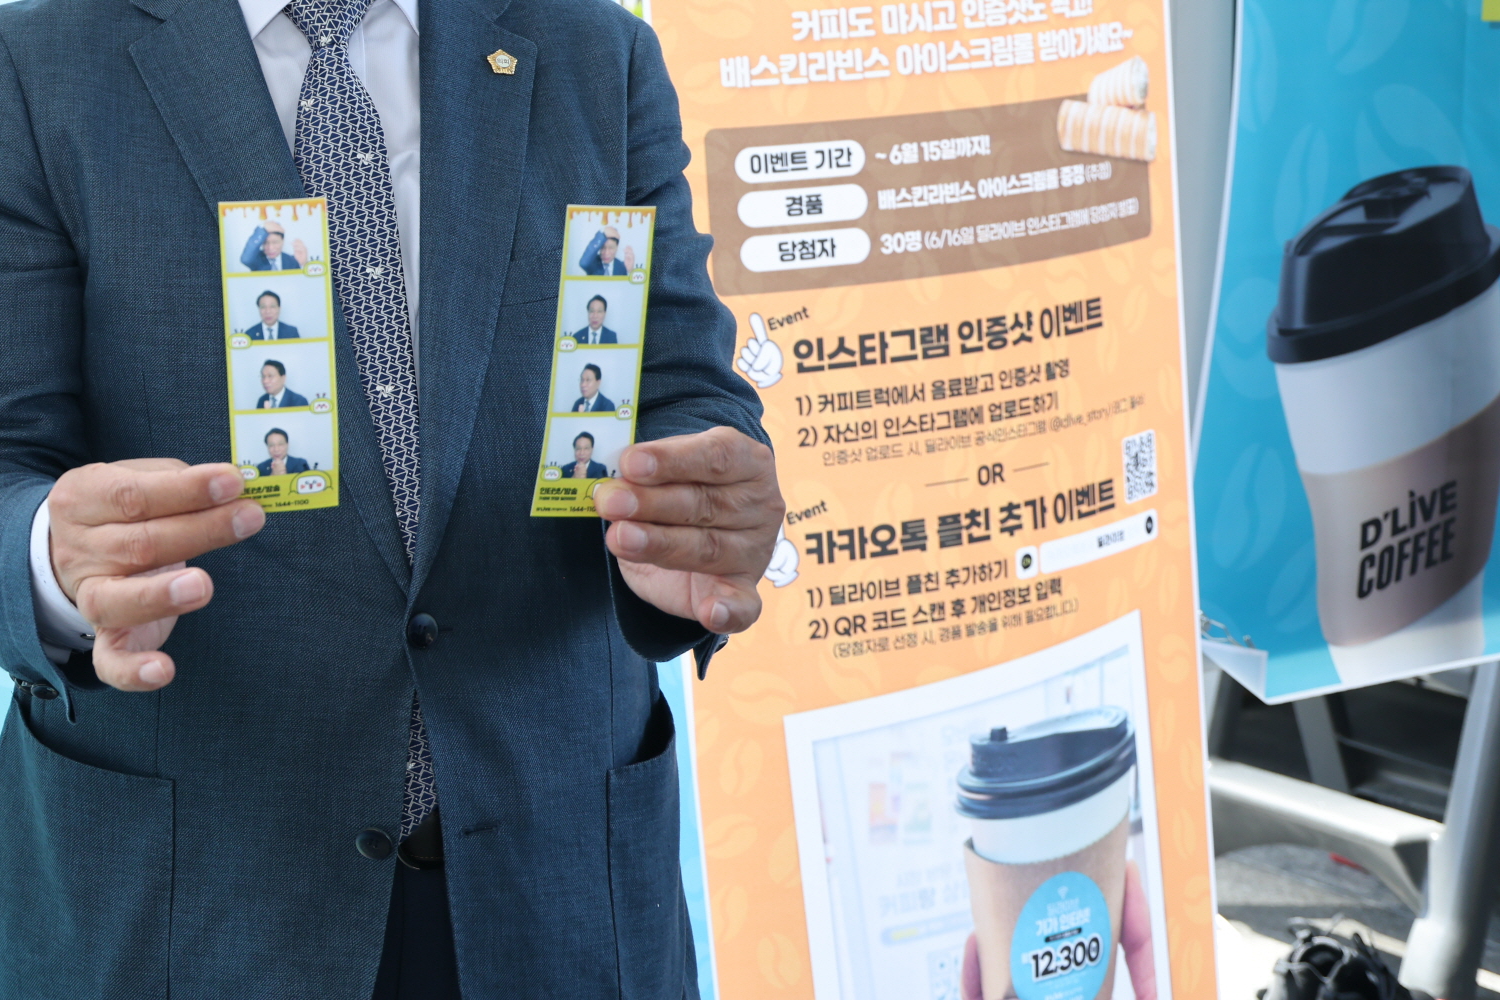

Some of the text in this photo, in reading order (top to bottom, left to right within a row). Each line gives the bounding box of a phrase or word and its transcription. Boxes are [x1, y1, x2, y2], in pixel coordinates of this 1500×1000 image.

[791, 6, 876, 41] 커피도
[881, 0, 958, 35] 마시고
[719, 46, 891, 88] 배스킨라빈스
[750, 146, 853, 174] 이벤트 기간
[889, 142, 919, 166] 6월
[921, 134, 991, 162] 15일까지!
[785, 193, 823, 217] 경품
[778, 237, 837, 263] 당첨자
[880, 230, 922, 254] 30명
[767, 306, 810, 332] Event
[792, 297, 1104, 374] 인스타그램 인증샷 이벤트
[795, 395, 812, 416] 1)
[817, 383, 926, 414] 커피트럭에서
[931, 373, 995, 401] 음료받고
[999, 364, 1042, 391] 인증샷
[798, 391, 1059, 447] 2) 자신의 인스타그램에 업로드하기
[977, 463, 1005, 486] OR
[786, 500, 828, 526] Event
[804, 479, 1117, 564] 카카오톡 플친 추가 이벤트
[1357, 517, 1457, 600] COFFEE
[806, 559, 1008, 608] 1) 딜라이브 플친 추가하기
[809, 618, 829, 640] 2)
[834, 614, 866, 637] QR
[872, 608, 907, 632] 코드
[912, 602, 946, 625] 스캔
[951, 599, 967, 619] 후
[971, 585, 1031, 614] 개인정보
